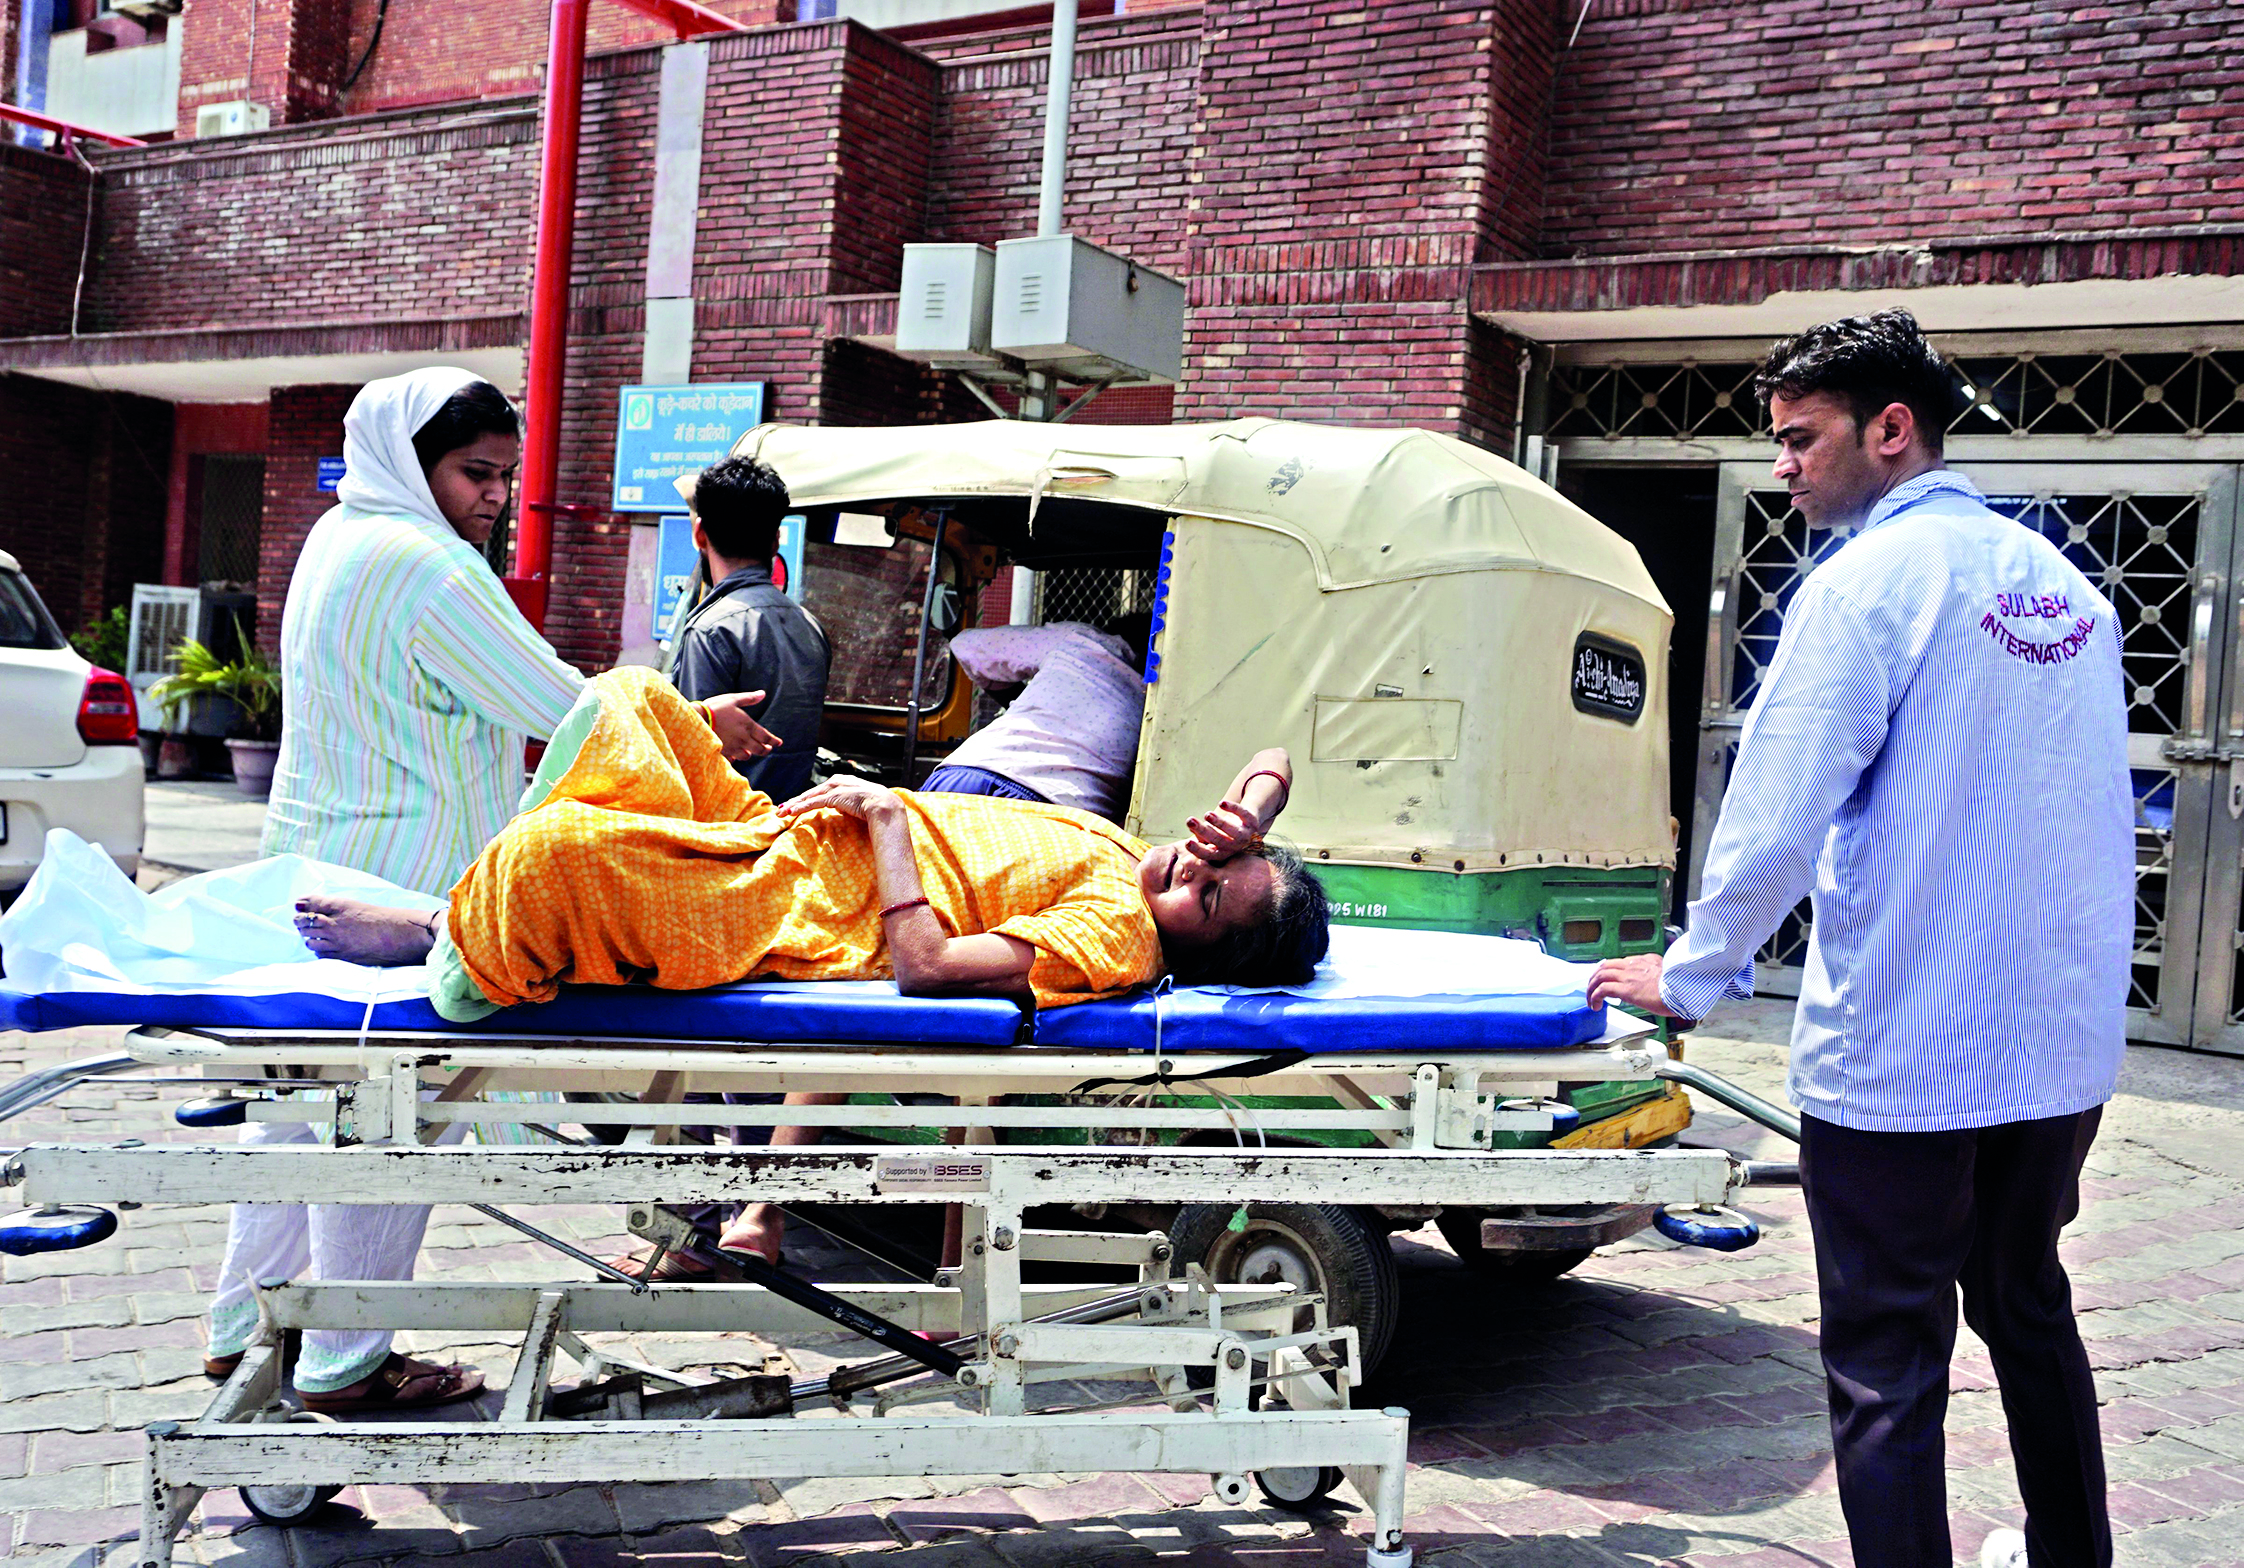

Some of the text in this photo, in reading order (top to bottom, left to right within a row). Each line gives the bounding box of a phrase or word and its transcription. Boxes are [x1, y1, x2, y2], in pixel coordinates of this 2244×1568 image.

[702, 392, 717, 410] को
[674, 422, 685, 441] में
[685, 422, 696, 442] ही
[1997, 593, 2072, 618] SULABH
[1980, 612, 2095, 664] INTERNATIONAL
[885, 1165, 983, 1176] Supported by BSES
